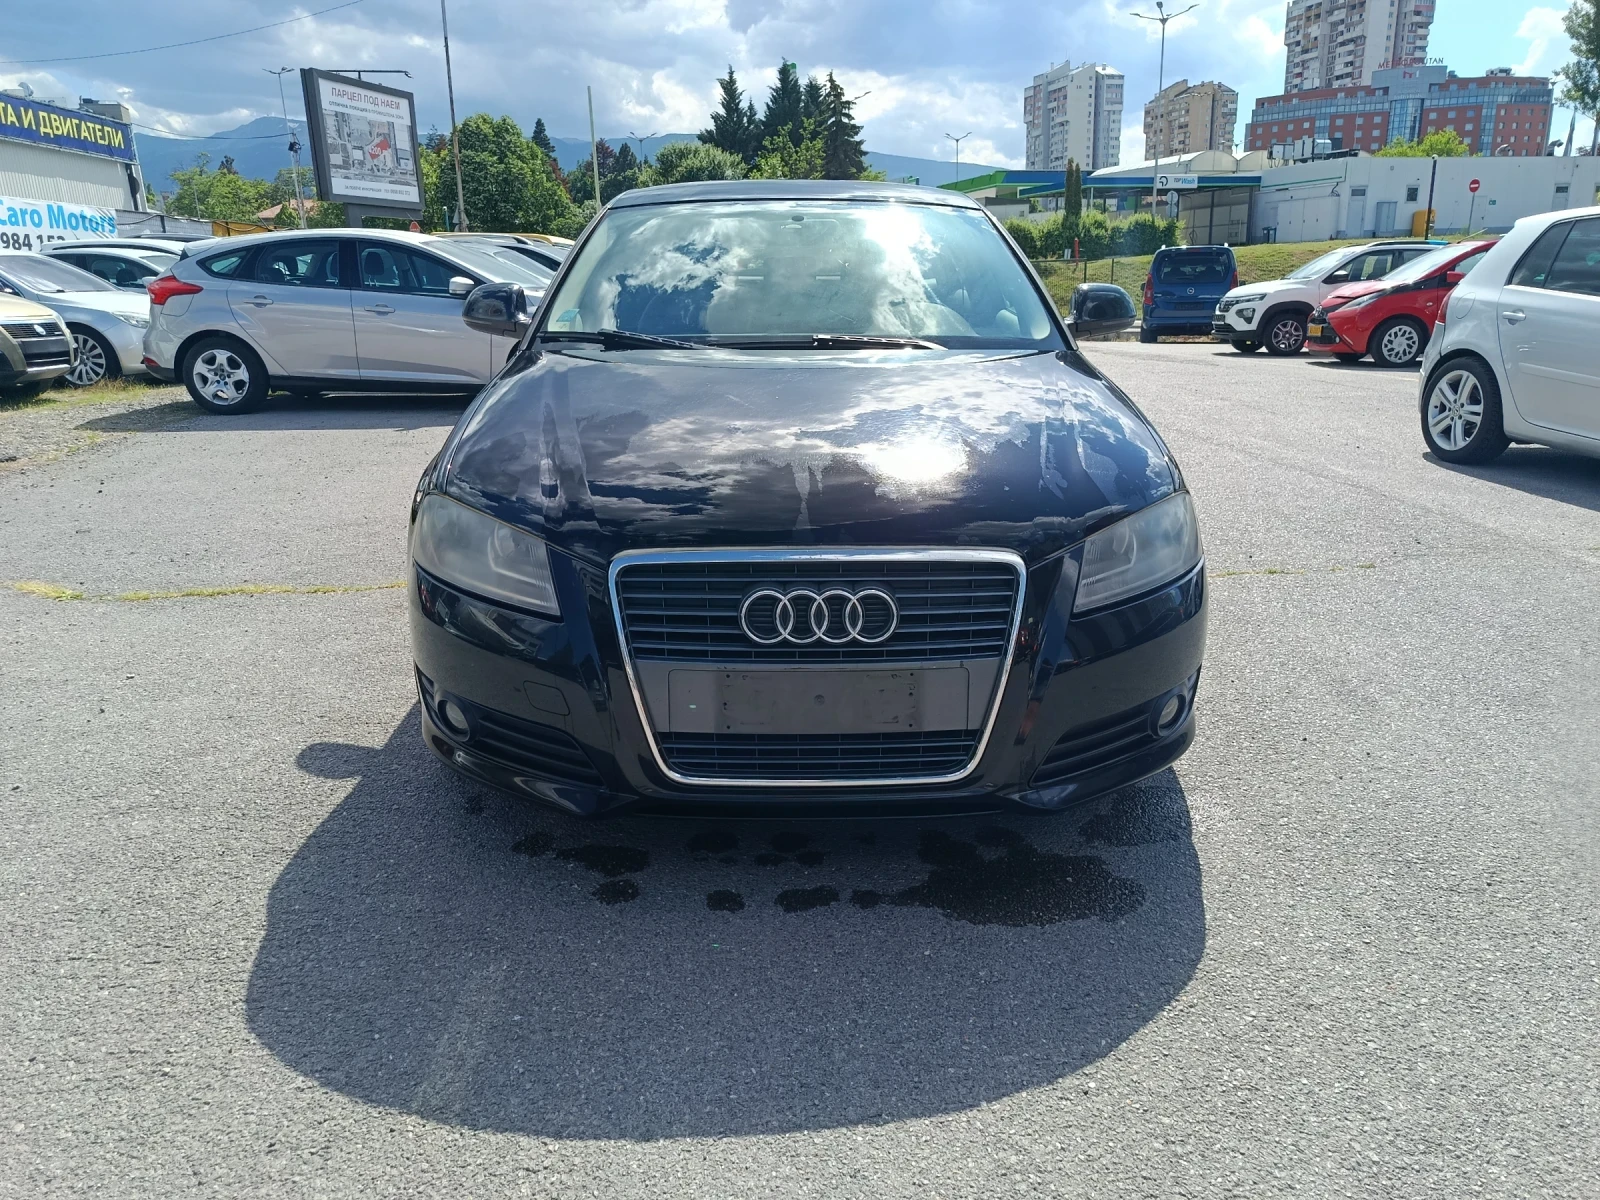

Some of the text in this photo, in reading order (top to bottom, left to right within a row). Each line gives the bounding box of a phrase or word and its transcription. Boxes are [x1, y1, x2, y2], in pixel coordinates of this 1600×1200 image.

[331, 87, 400, 110] ПАРЦЕЛ ПОД НАЕМ
[20, 106, 36, 130] И
[38, 111, 124, 149] ДВИГАТЕЛИ
[46, 204, 116, 234] Motors
